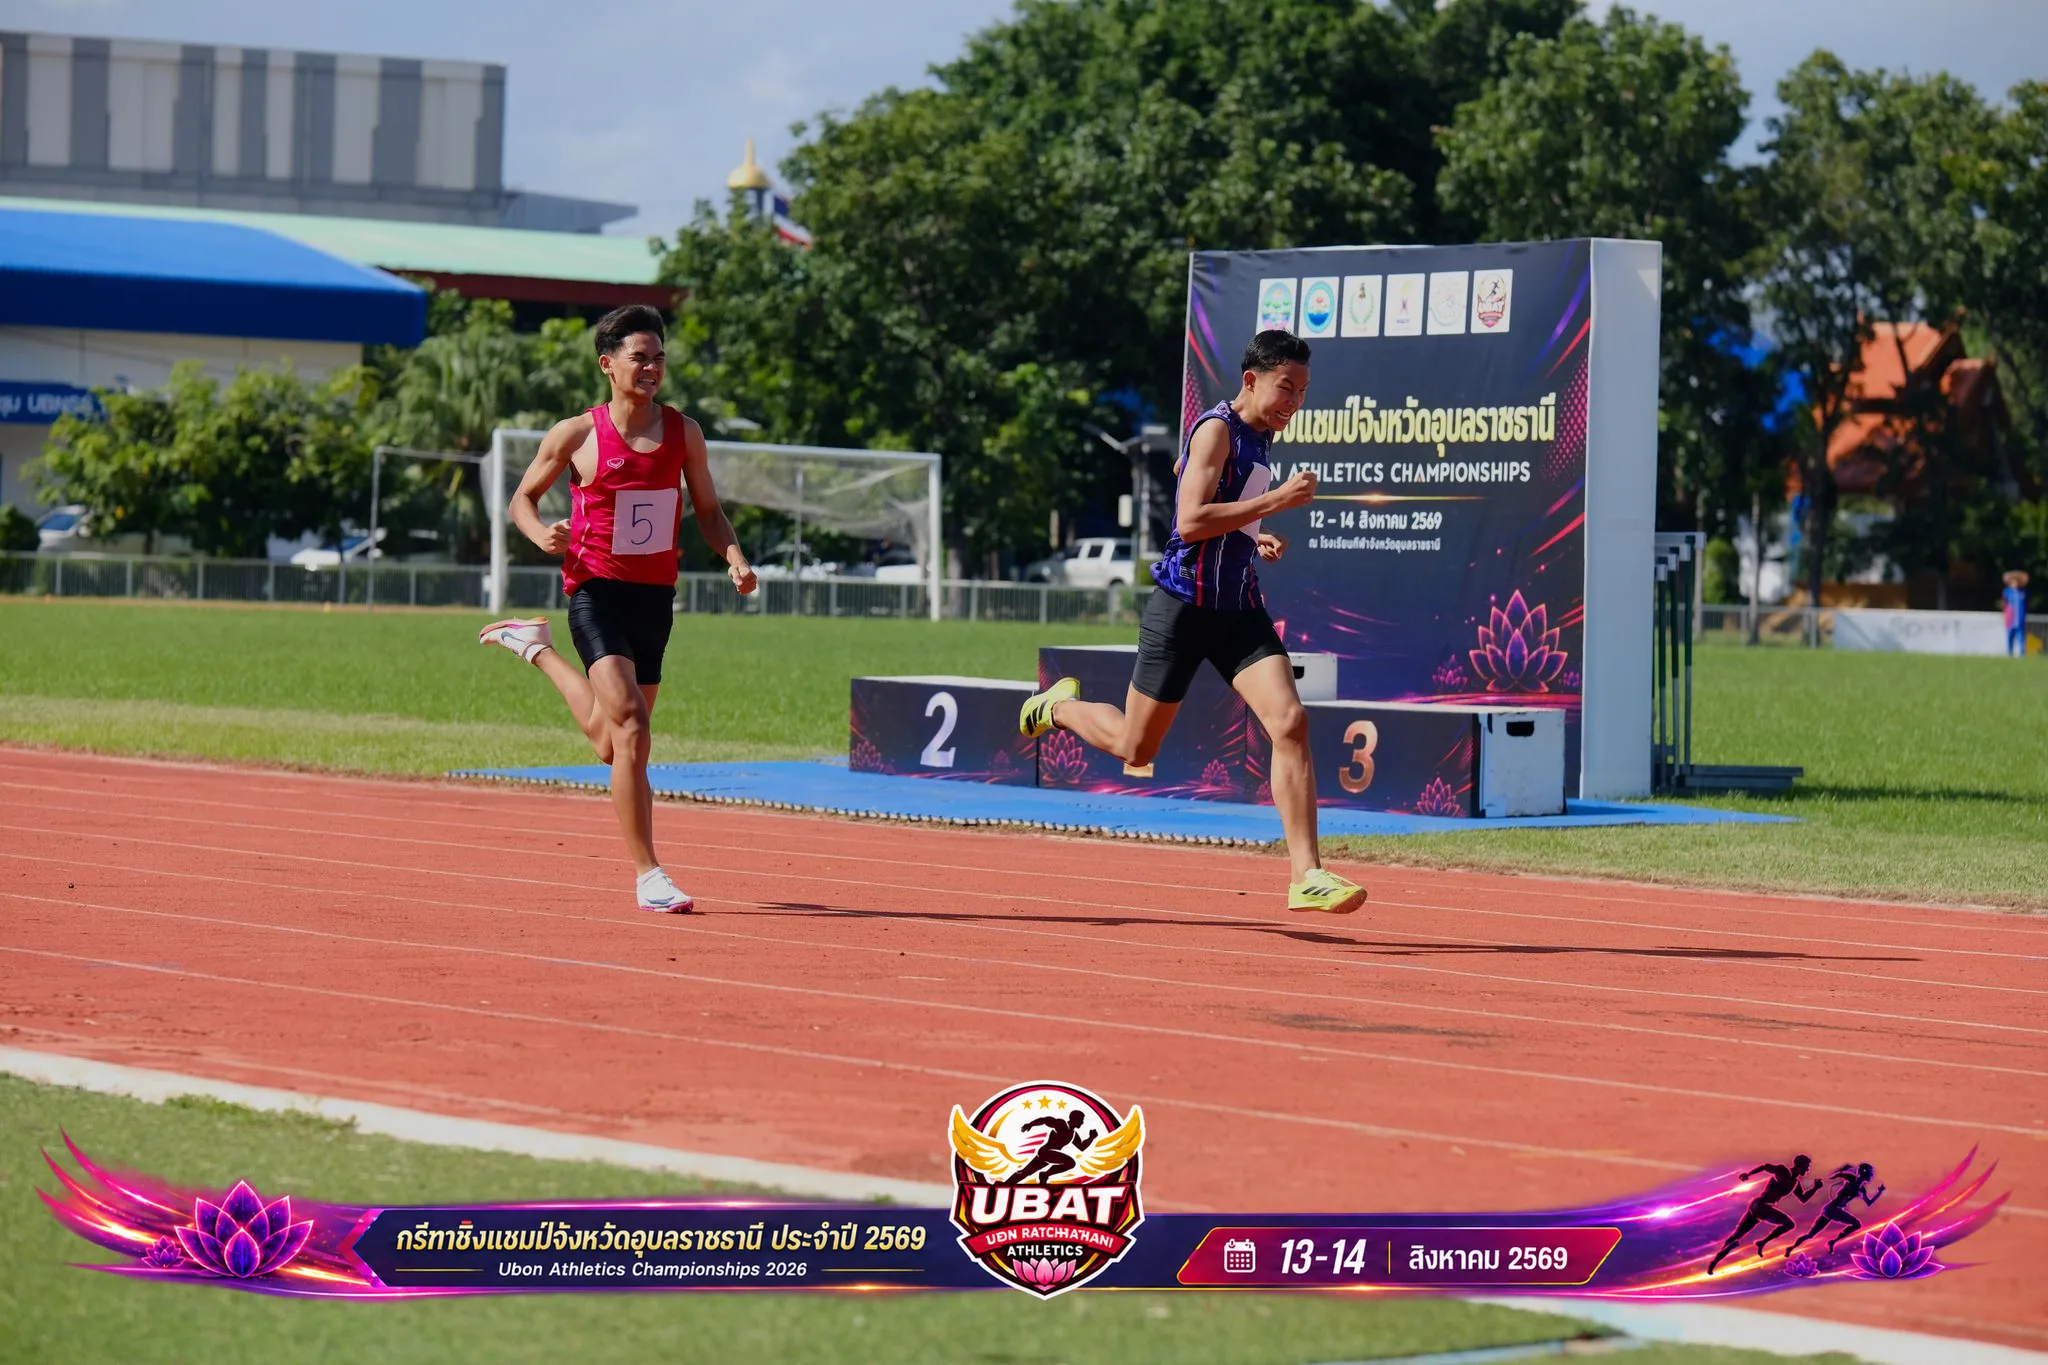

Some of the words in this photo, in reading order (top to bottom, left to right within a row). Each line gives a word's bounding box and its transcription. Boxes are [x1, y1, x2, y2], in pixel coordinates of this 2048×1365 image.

[1288, 462, 1384, 483] ATHLETICS
[1390, 461, 1531, 483] CHAMPIONSHIPS
[631, 503, 654, 545] 5
[1310, 510, 1325, 528] 12
[1340, 511, 1355, 529] 14
[1359, 510, 1408, 529] สิงหาคม
[1411, 511, 1443, 530] 2569
[920, 691, 959, 768] 2
[1338, 720, 1379, 794] 3
